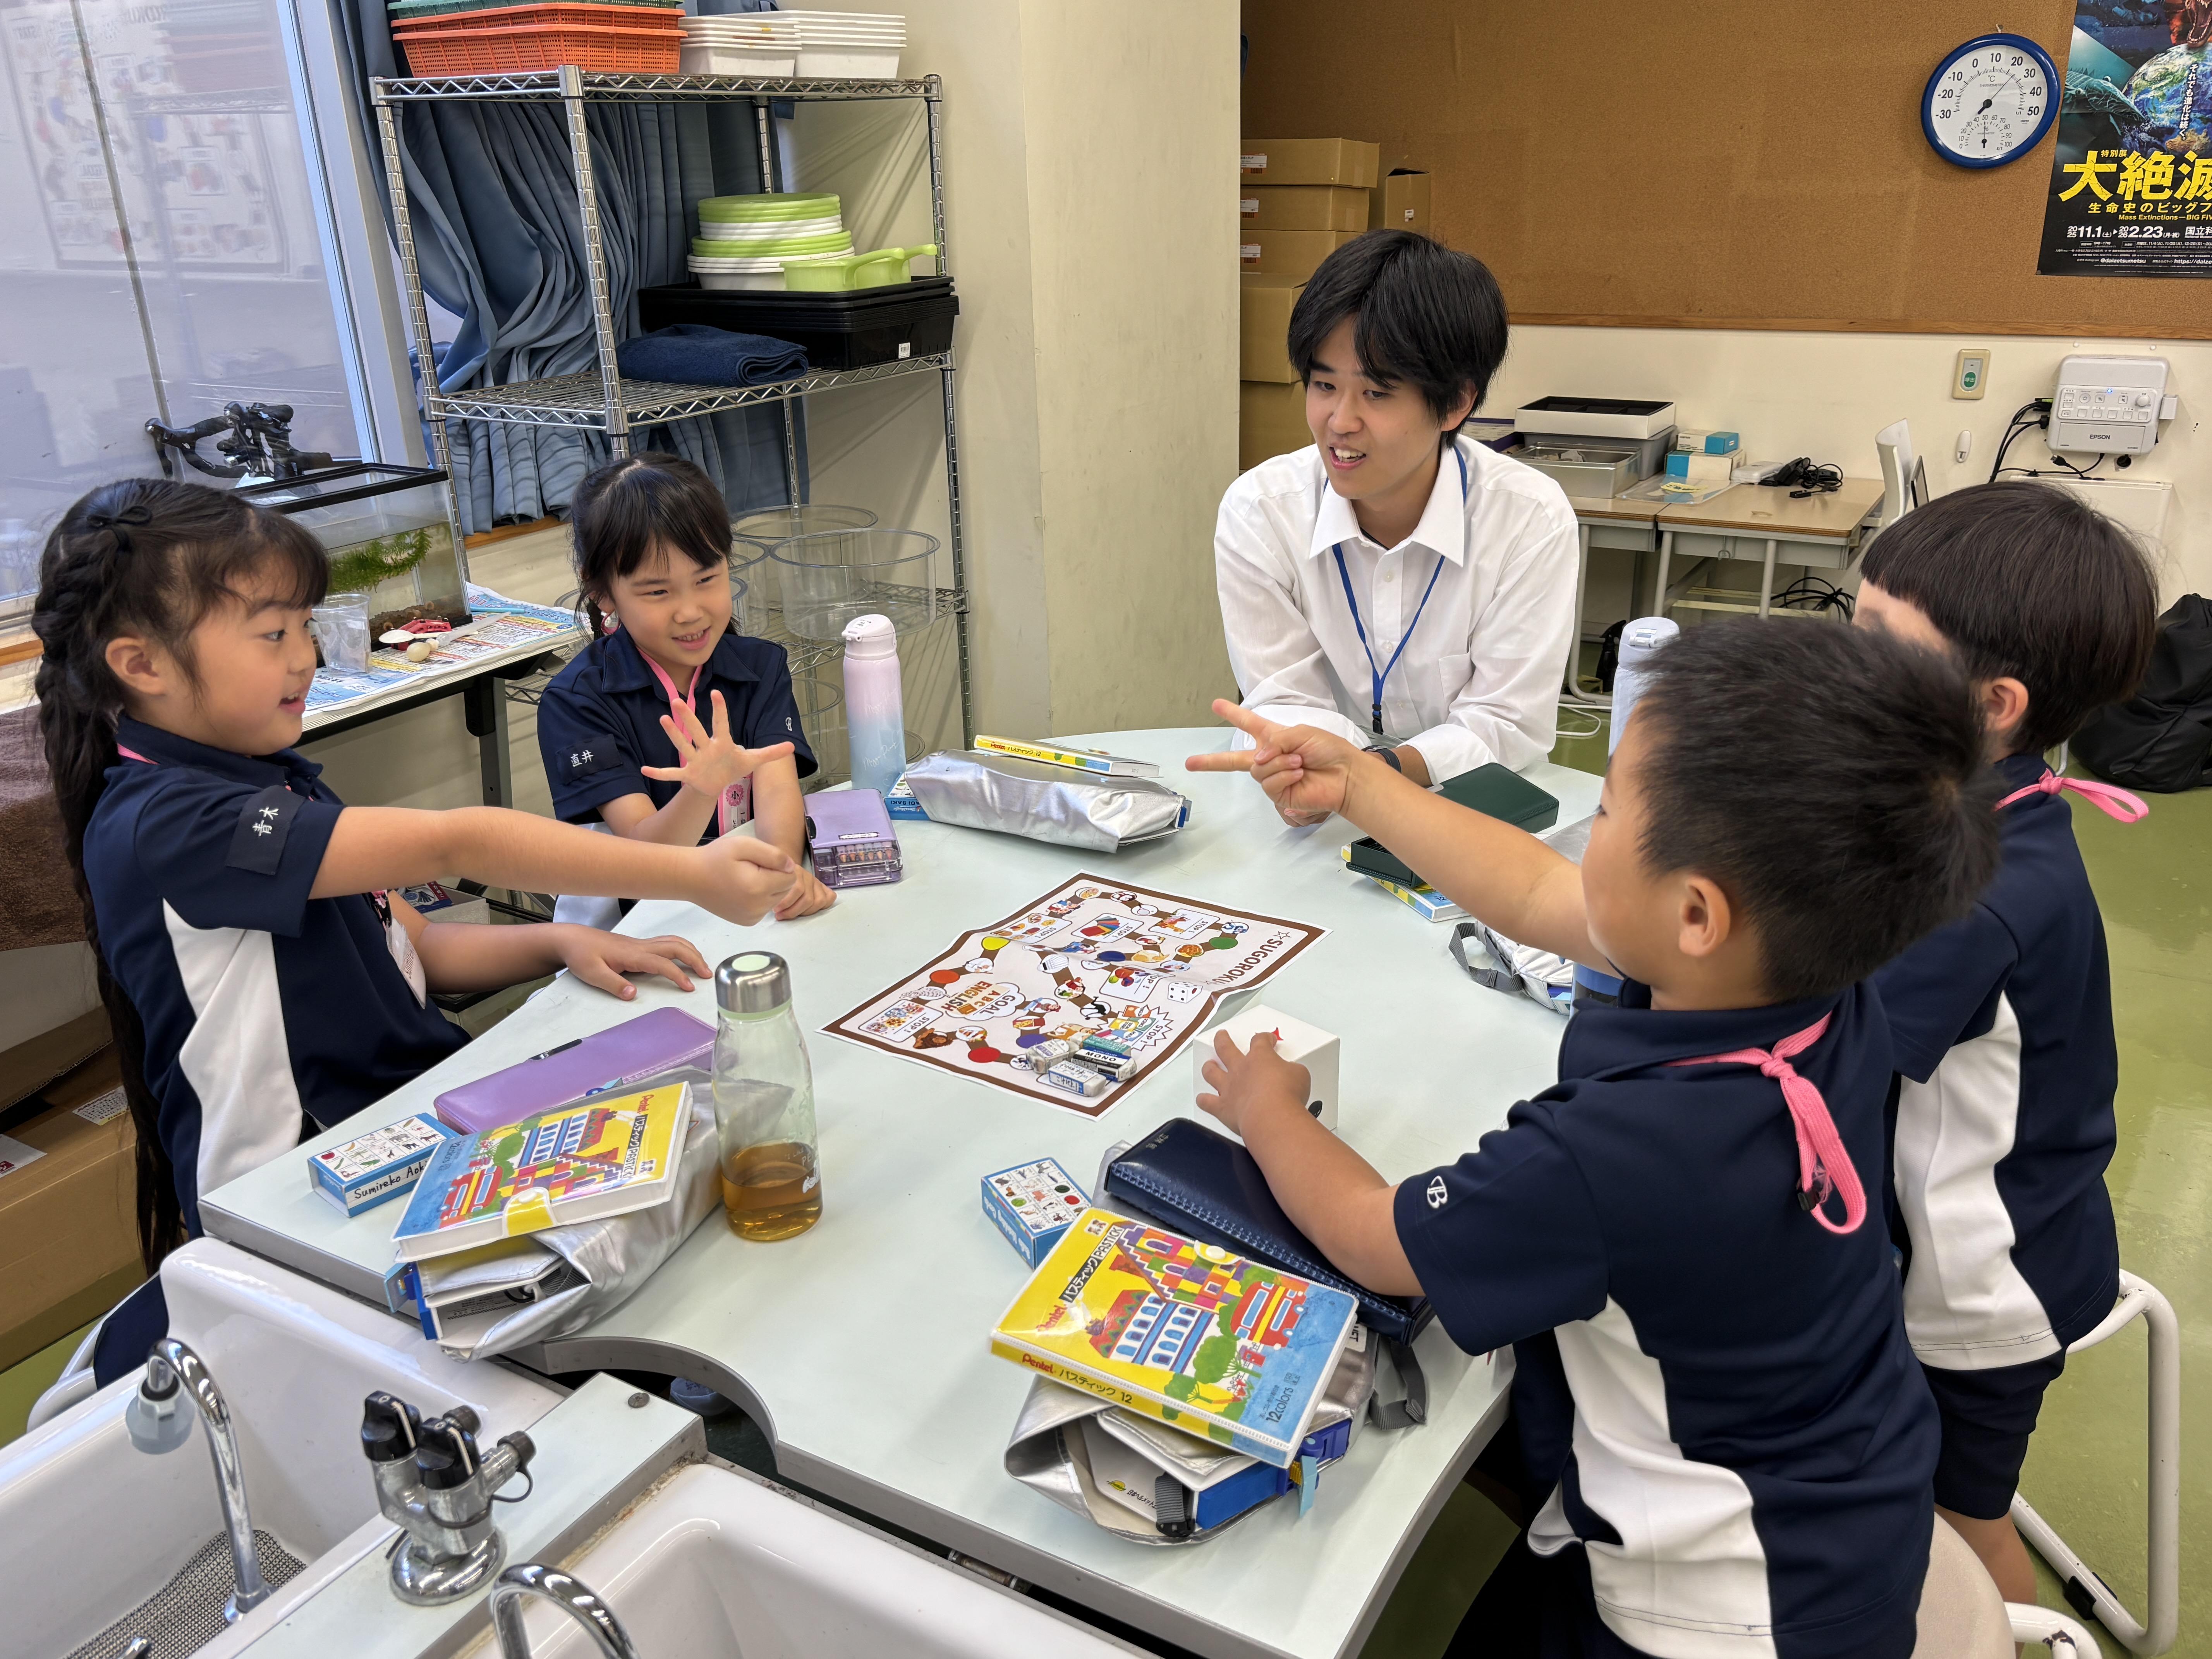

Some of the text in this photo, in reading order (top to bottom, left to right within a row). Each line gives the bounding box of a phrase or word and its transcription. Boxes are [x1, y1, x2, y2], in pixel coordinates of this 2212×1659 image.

[1972, 58, 1978, 68] 0
[1990, 53, 2001, 62] 10
[2011, 56, 2023, 66] 20
[1948, 71, 1963, 81] -10
[2023, 68, 2036, 78] 30
[1938, 89, 1953, 98] -20
[2030, 86, 2042, 96] 40
[2179, 64, 2198, 140] それでも進化は続く。
[1936, 109, 1951, 119] -30
[2027, 106, 2039, 116] 50
[2088, 202, 2212, 213] 生命史のビッグフ
[570, 750, 594, 768] 直井
[252, 807, 279, 837] 青木
[1212, 938, 1283, 984] SUGOROKU
[941, 981, 993, 1012] ENGLISH
[979, 995, 1016, 1014] GOAL
[1085, 1052, 1116, 1061] MONO
[622, 1149, 638, 1177] PASTICK
[354, 1160, 428, 1199] Sumireko Aok
[1094, 1226, 1123, 1257] PASTICK
[1063, 1258, 1097, 1300] パスティック
[1022, 1353, 1133, 1404] Pentel パスティック 12
